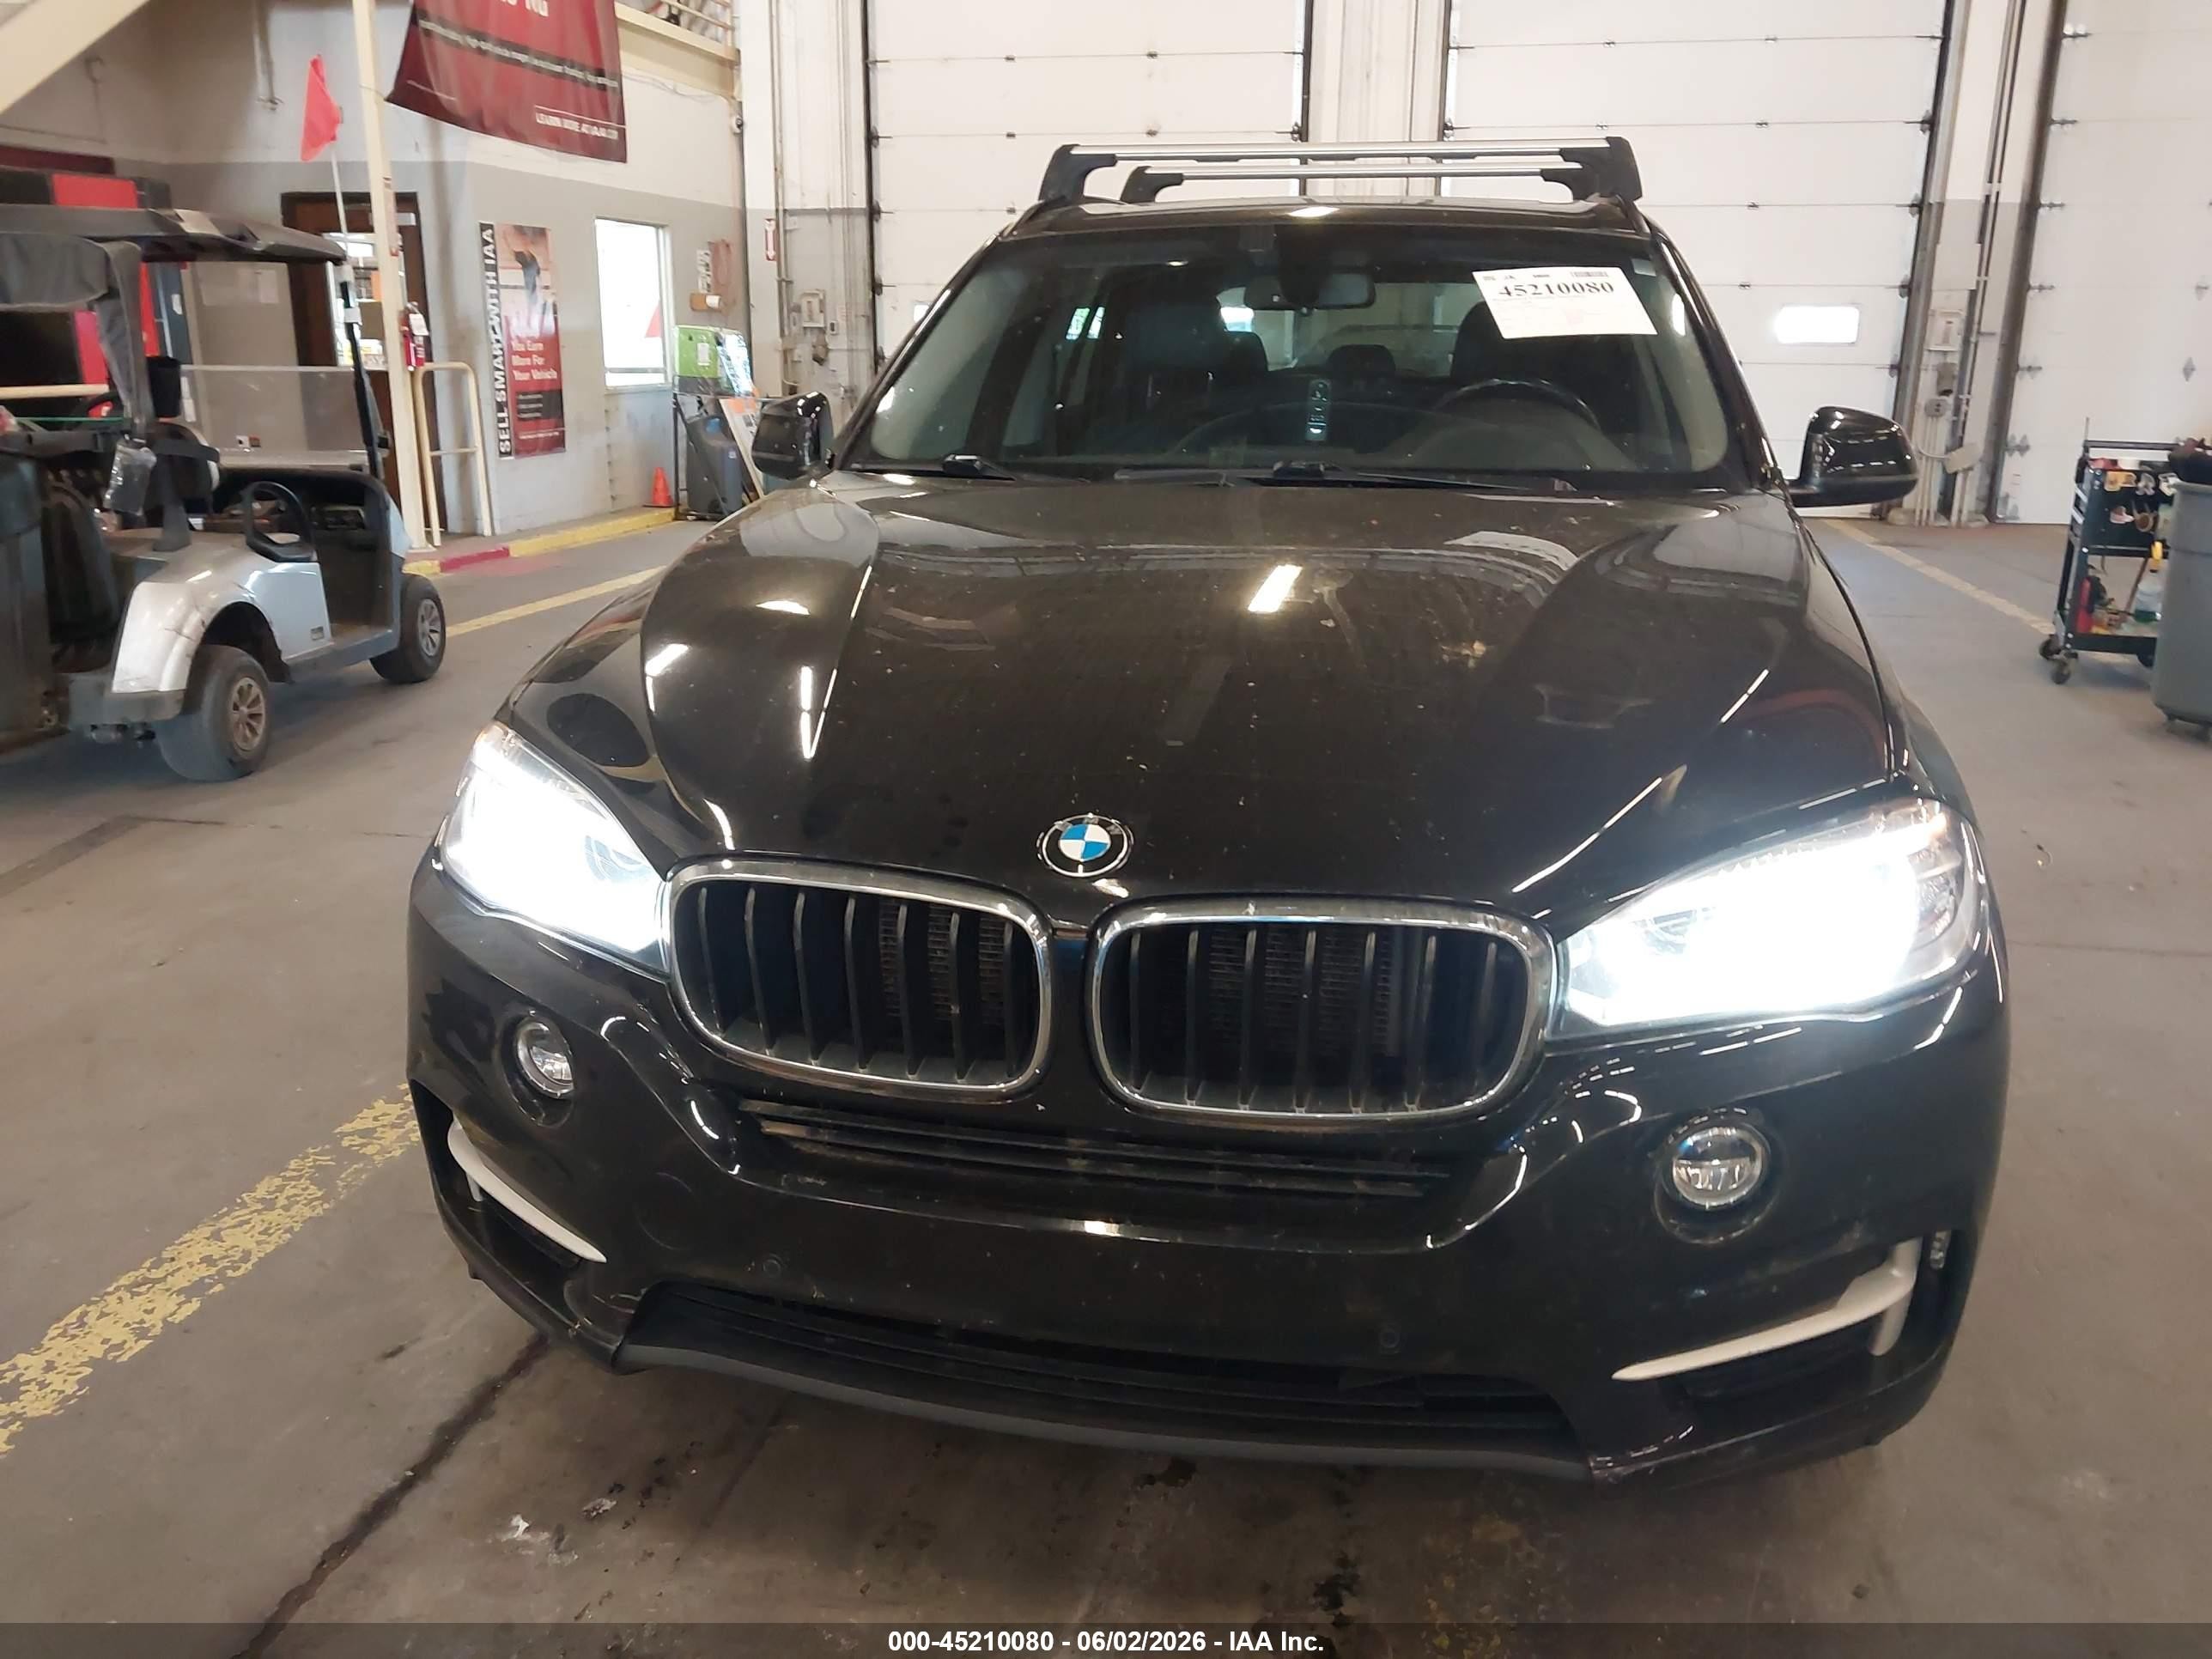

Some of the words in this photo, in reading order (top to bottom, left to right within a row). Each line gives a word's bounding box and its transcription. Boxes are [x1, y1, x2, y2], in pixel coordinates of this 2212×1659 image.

[481, 228, 496, 266] IAA
[483, 270, 501, 325] WITH
[1498, 281, 1615, 297] 45210080
[489, 326, 508, 403] SMART
[496, 405, 513, 455] SELL
